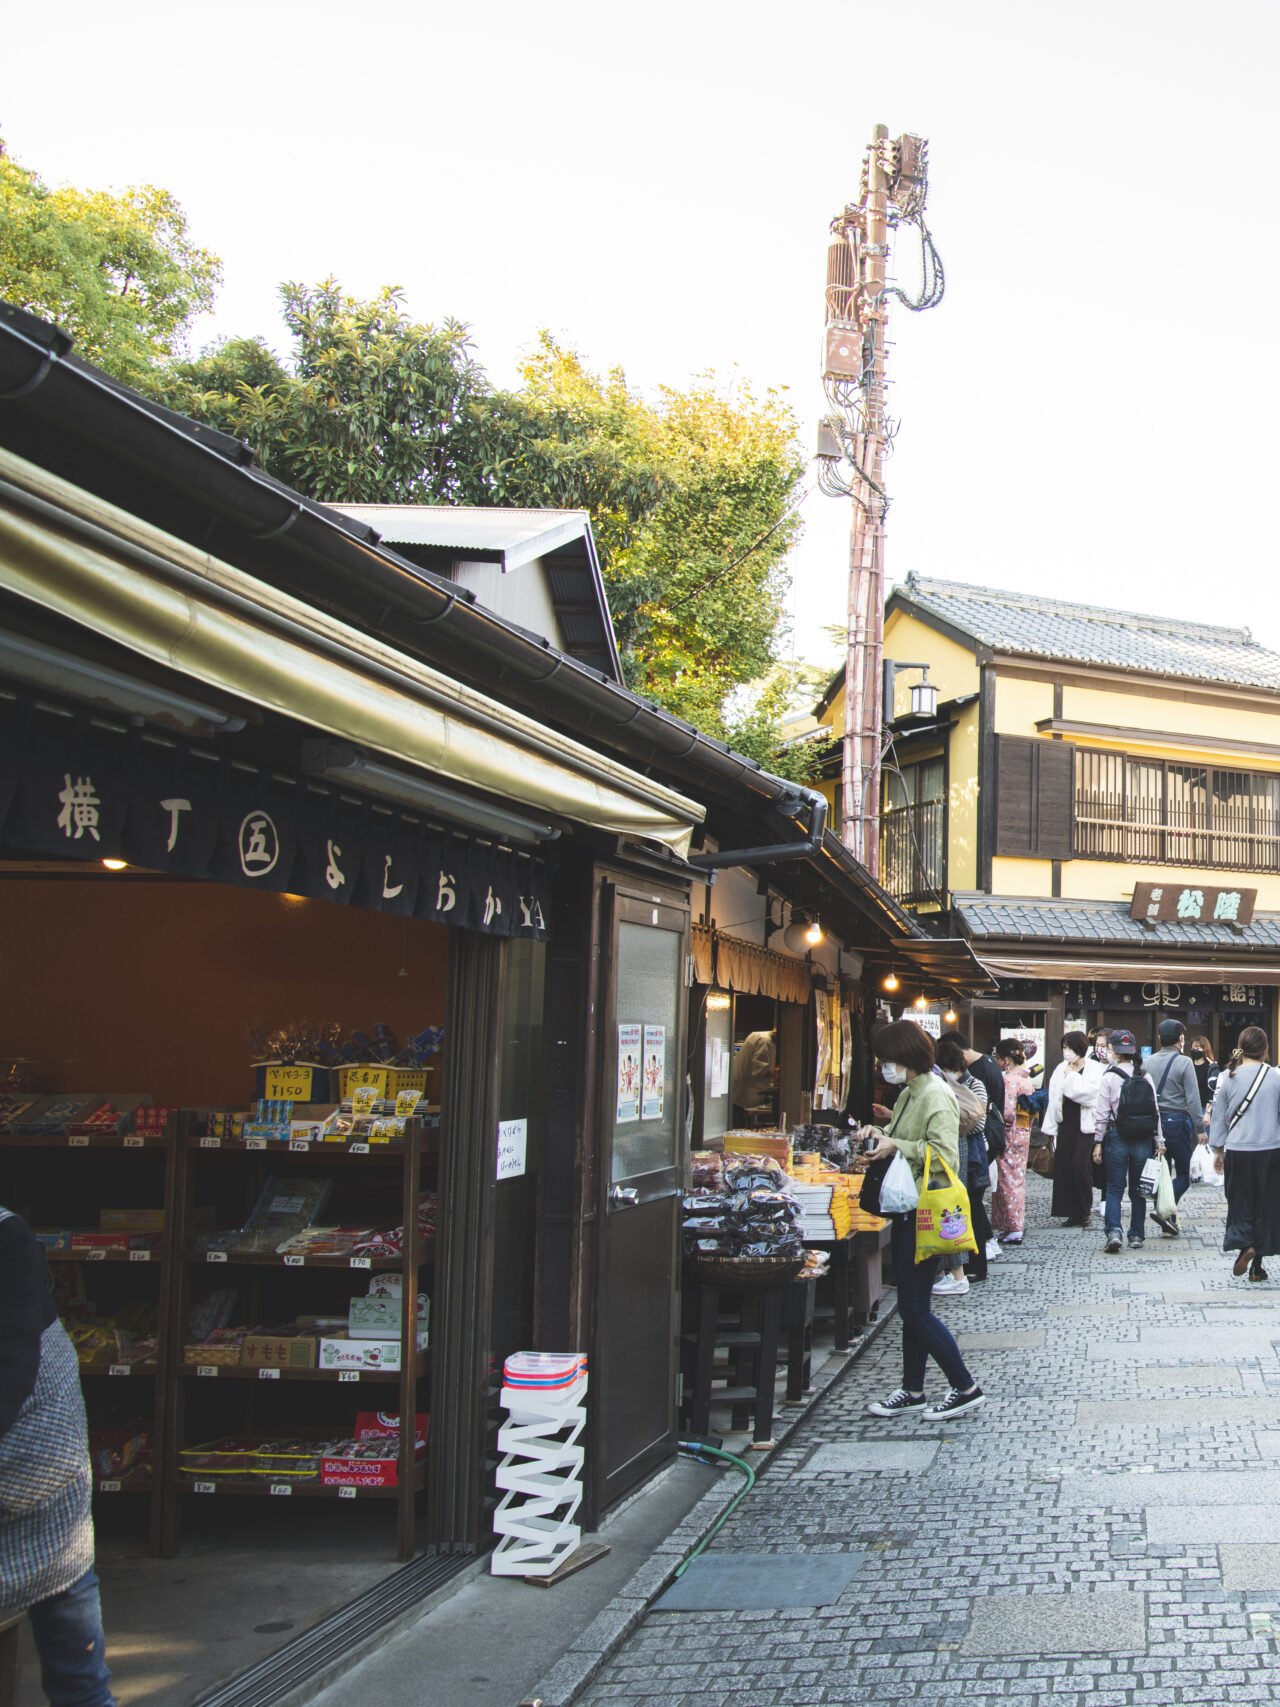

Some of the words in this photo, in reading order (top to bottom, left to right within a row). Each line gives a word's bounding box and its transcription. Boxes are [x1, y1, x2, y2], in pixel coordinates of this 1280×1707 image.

[519, 895, 546, 930] YA
[272, 1084, 303, 1096] ¥150
[247, 1344, 287, 1360] すもも
